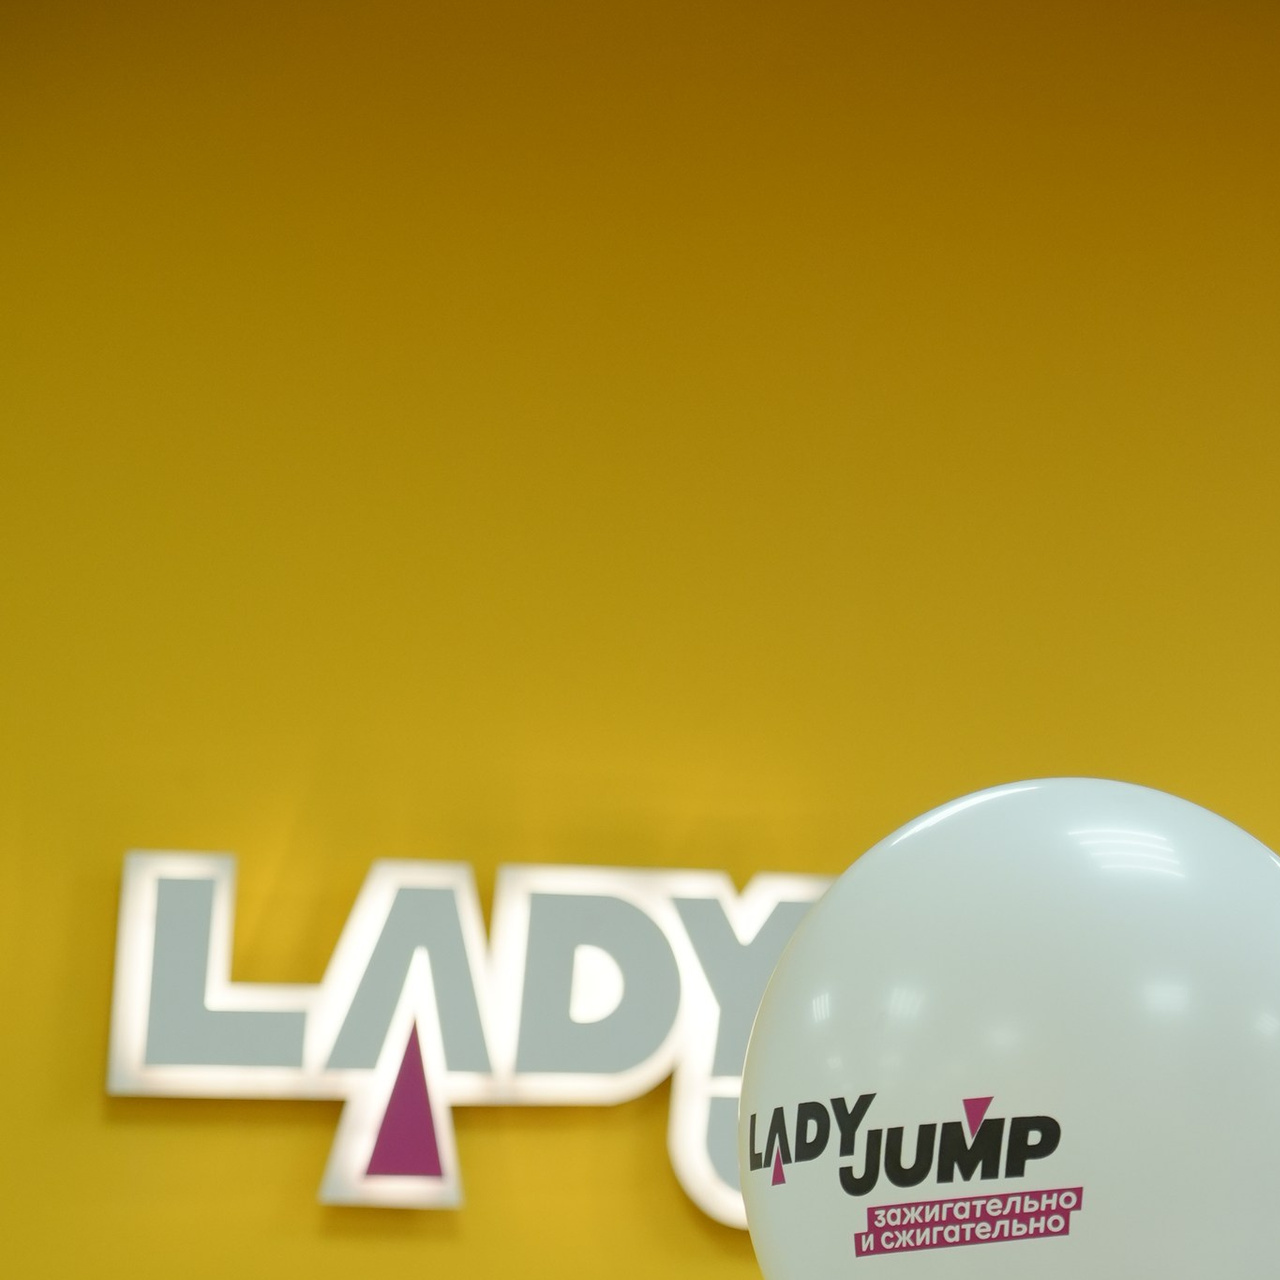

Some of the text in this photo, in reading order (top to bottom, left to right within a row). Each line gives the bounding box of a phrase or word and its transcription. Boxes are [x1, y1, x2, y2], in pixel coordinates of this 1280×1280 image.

[143, 876, 822, 1177] LADY
[750, 1092, 877, 1186] LADY
[839, 1096, 1061, 1197] JUMP
[861, 1214, 1065, 1252] и сжигательно
[874, 1191, 1078, 1228] зажигательно
